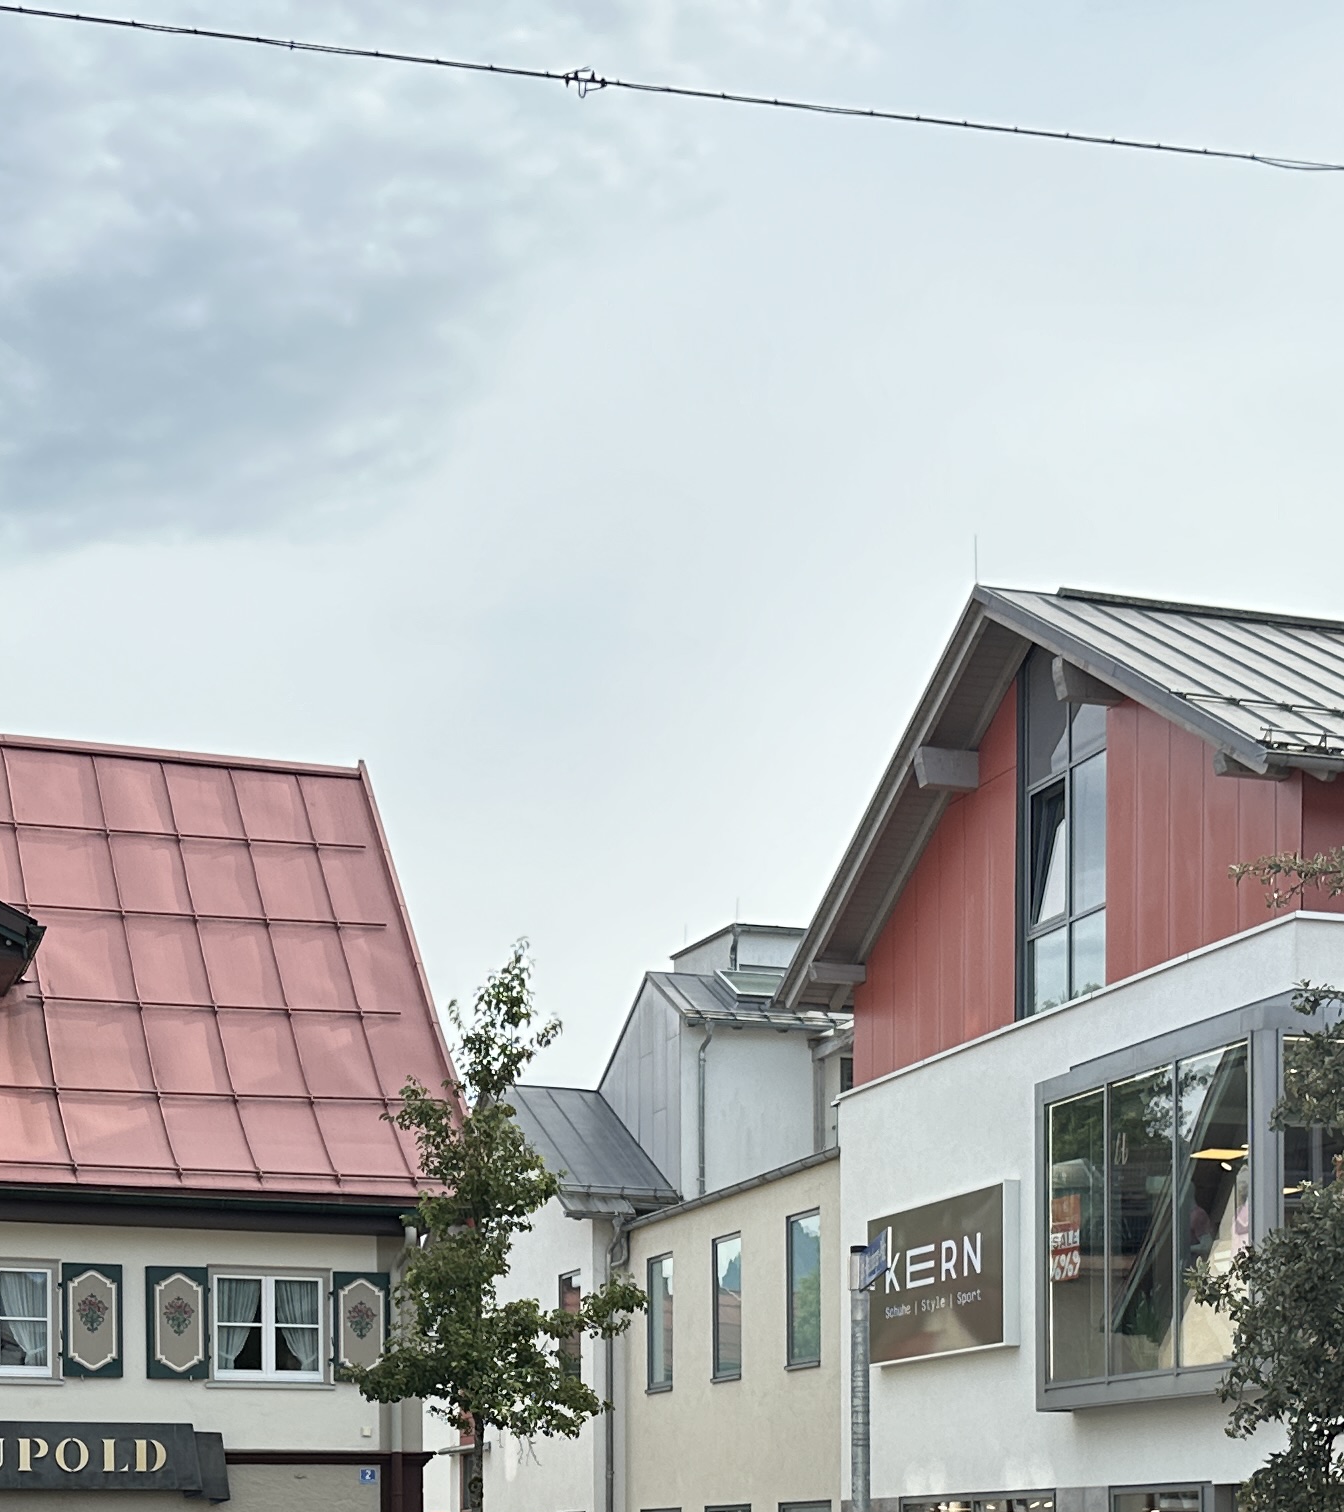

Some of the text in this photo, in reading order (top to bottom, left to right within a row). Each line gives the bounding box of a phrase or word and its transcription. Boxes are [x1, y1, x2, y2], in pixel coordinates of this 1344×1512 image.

[886, 1232, 981, 1294] KERN
[885, 1289, 981, 1319] Schuhe Style Sport
